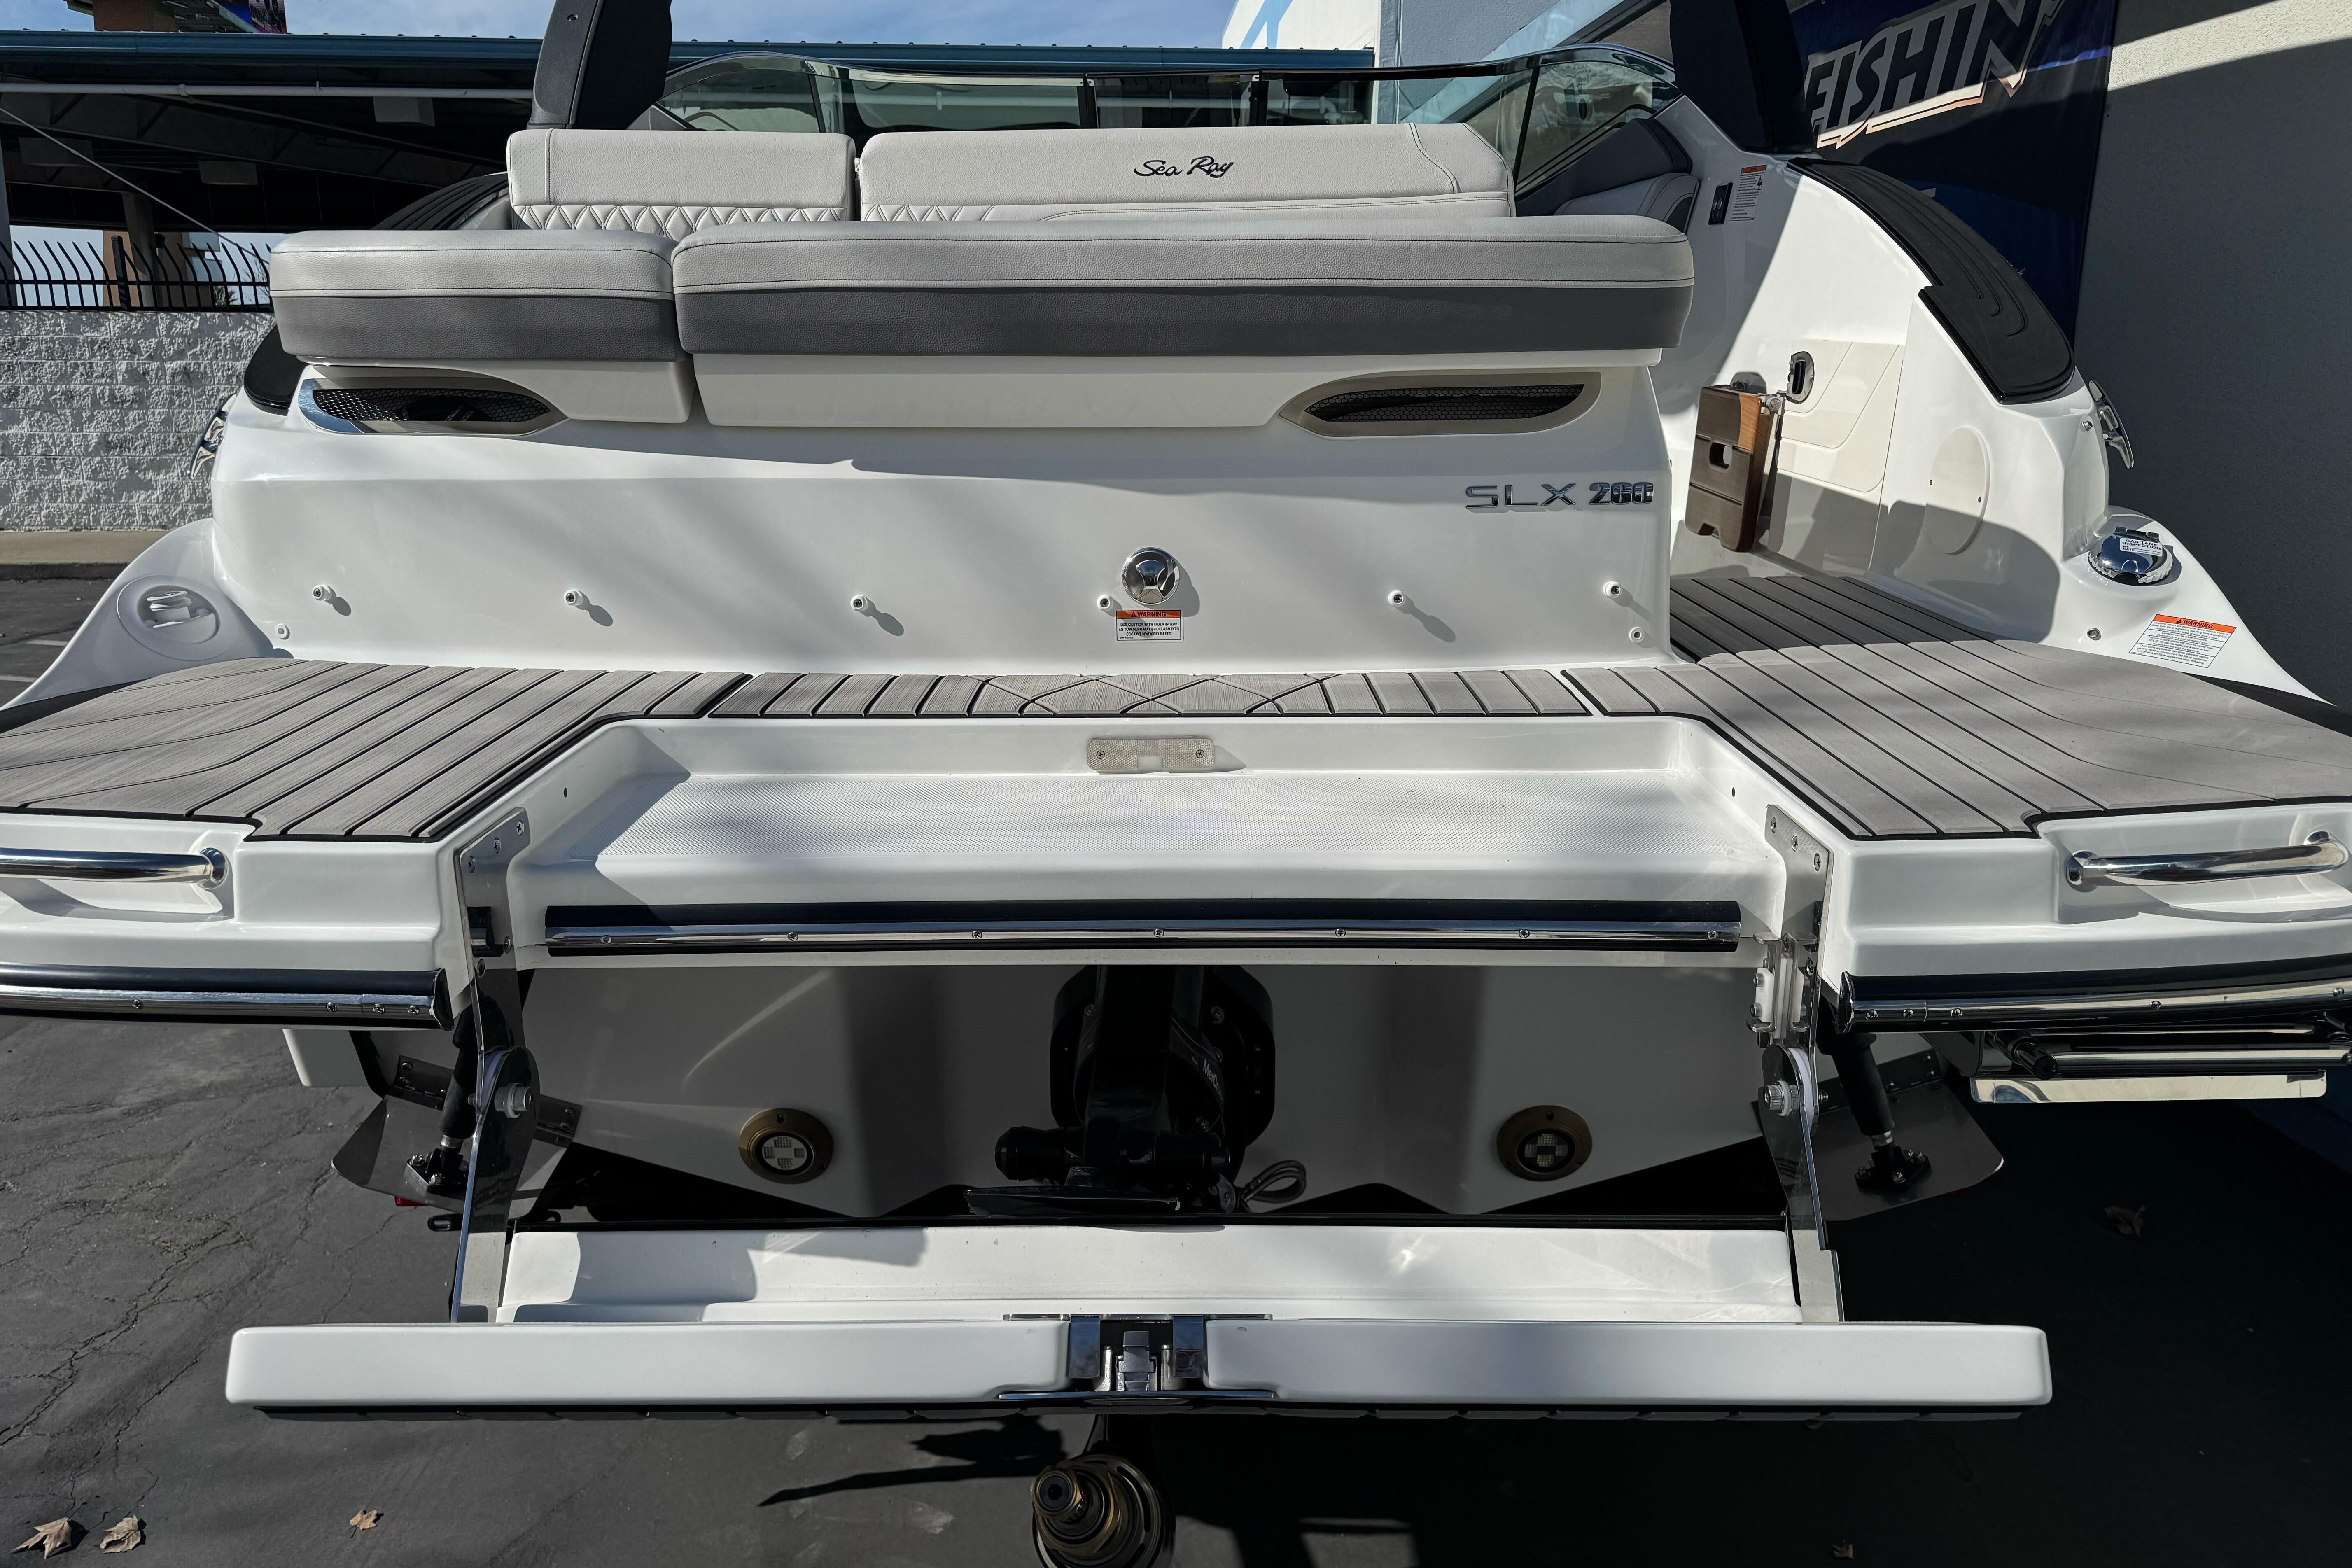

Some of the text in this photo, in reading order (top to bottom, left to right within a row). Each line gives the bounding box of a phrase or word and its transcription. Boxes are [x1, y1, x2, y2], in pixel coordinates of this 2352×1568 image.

[1133, 156, 1234, 178] Sea Ray
[1466, 483, 1577, 509] SLX
[2122, 541, 2161, 550] INSPECTION
[2183, 619, 2214, 629] WARNING
